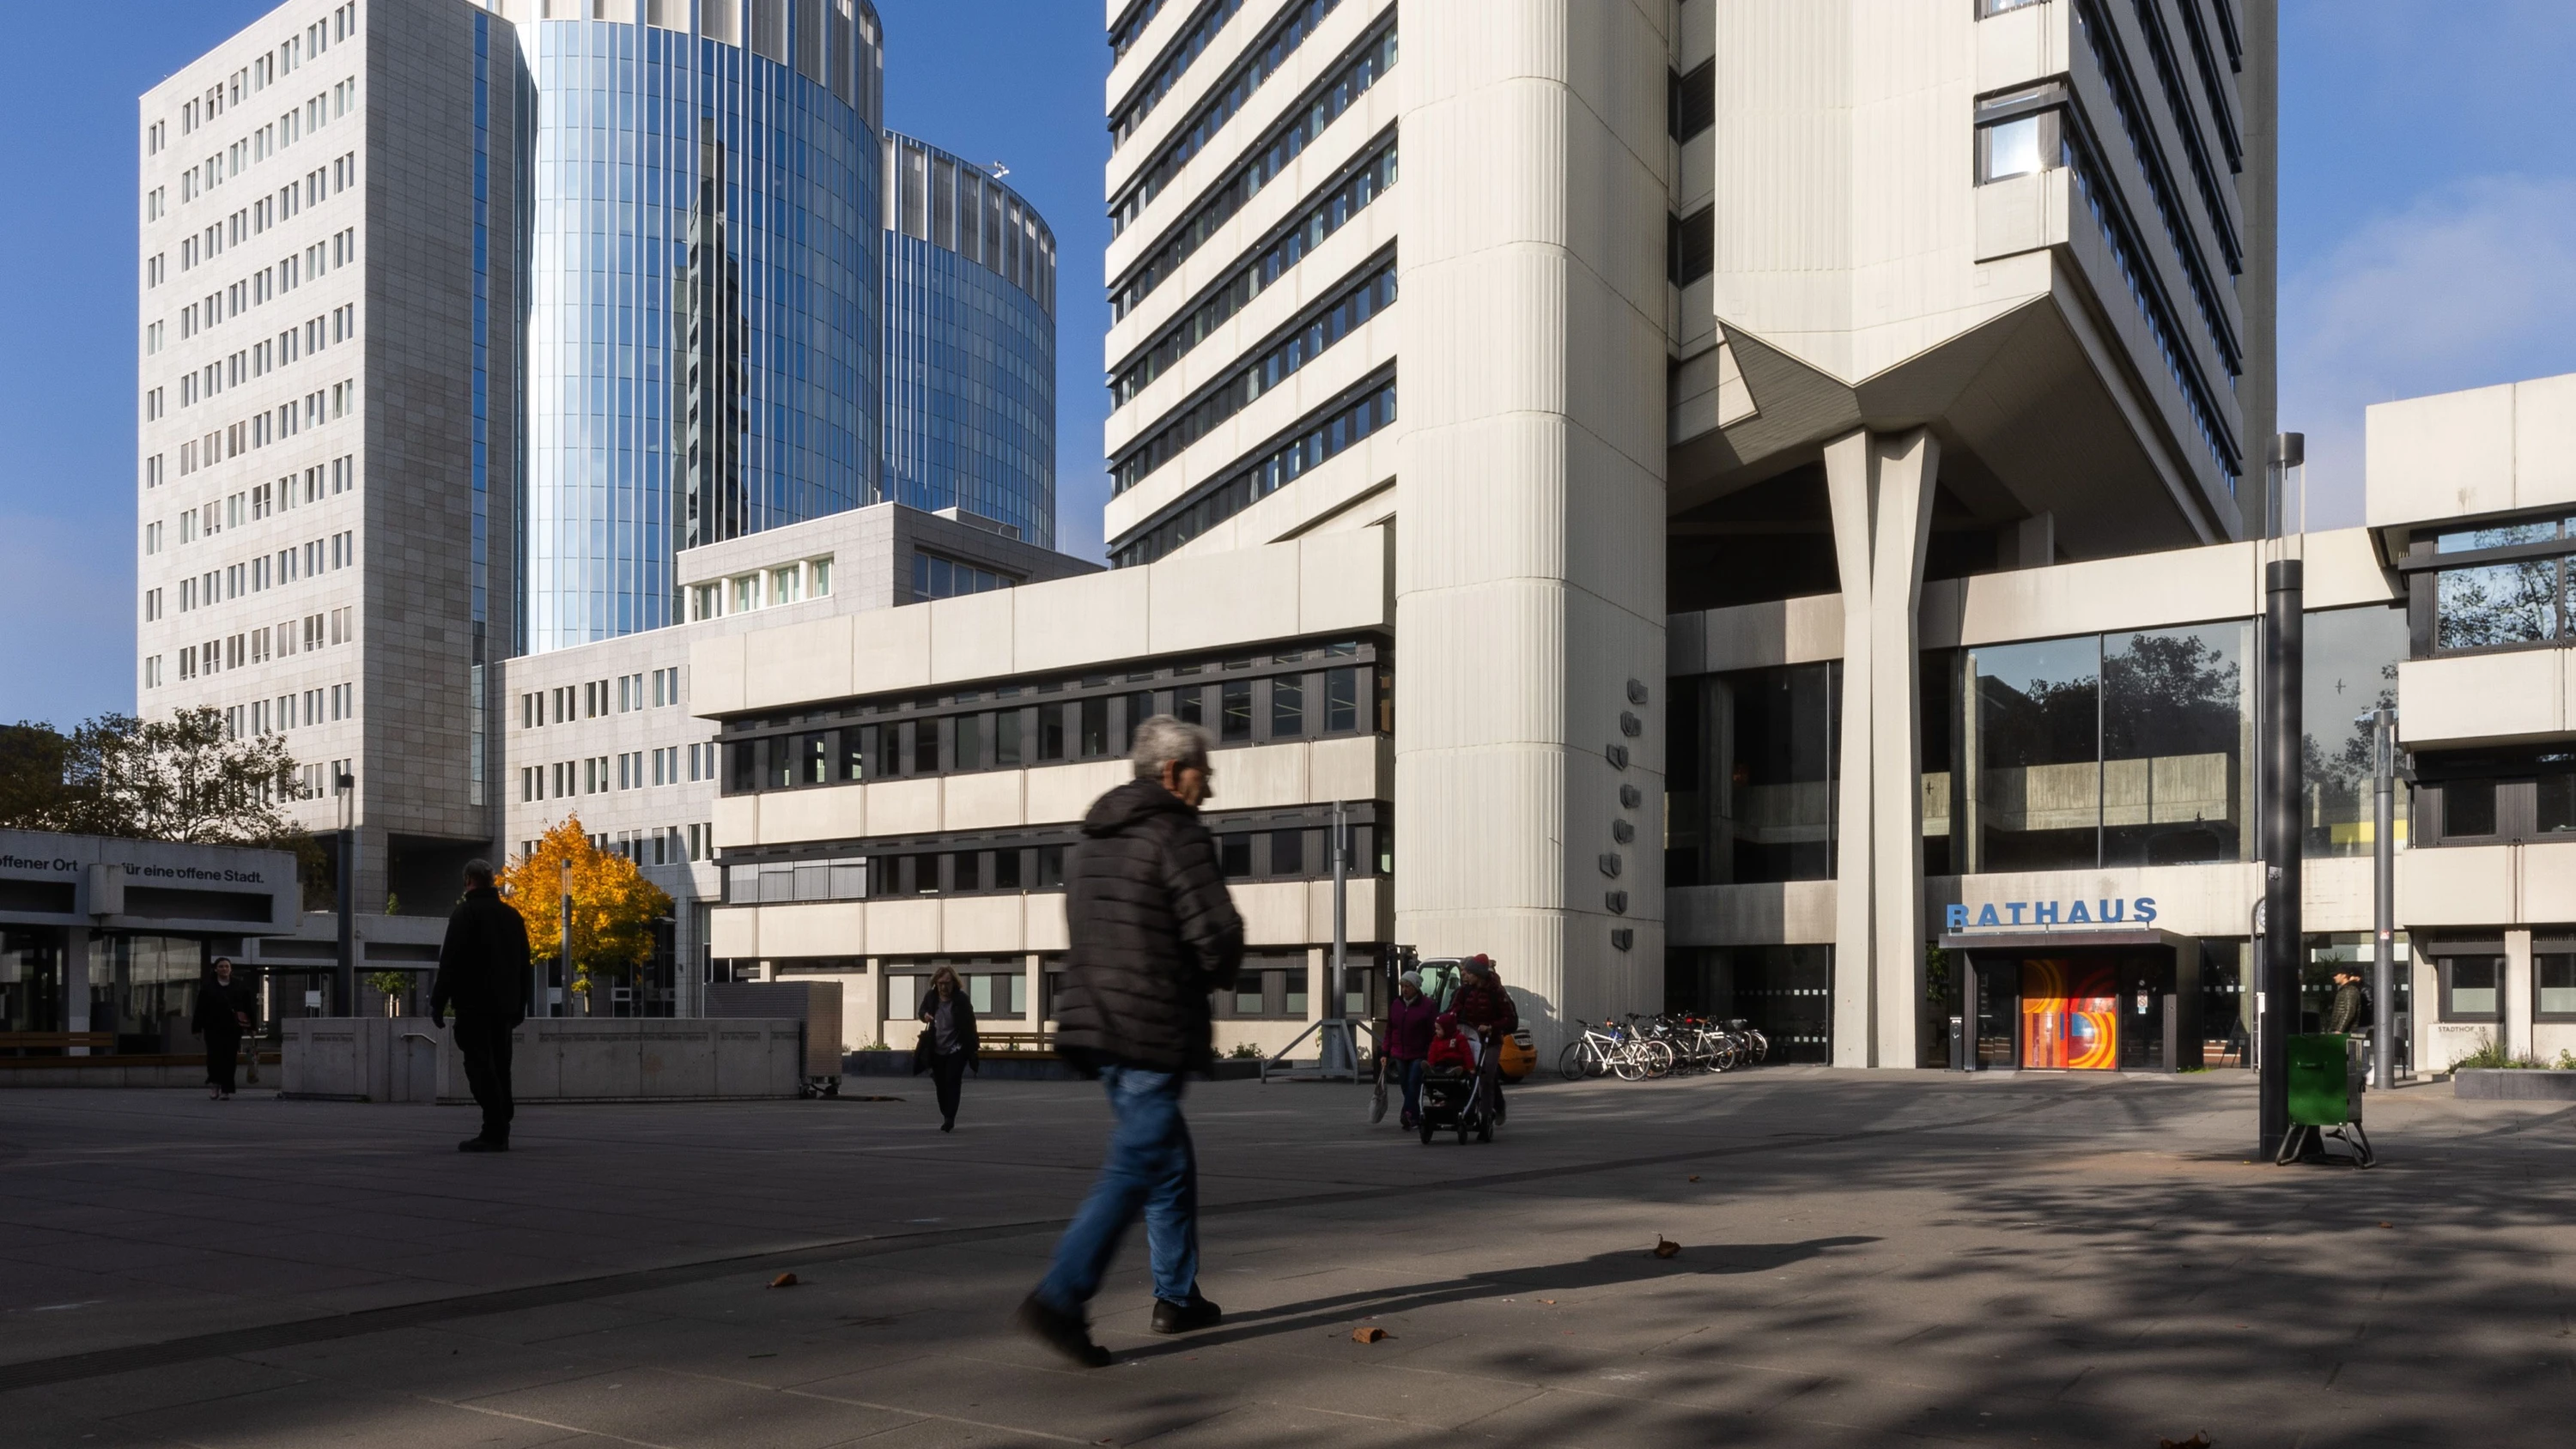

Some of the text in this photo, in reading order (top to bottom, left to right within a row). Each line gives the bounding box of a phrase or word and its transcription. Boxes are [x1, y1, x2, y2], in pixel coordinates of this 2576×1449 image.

[0, 855, 78, 872] ffener Ort
[143, 864, 174, 878] eine
[176, 867, 222, 881] offene
[223, 870, 264, 884] Stadt.
[1947, 897, 2157, 928] RATHAUS
